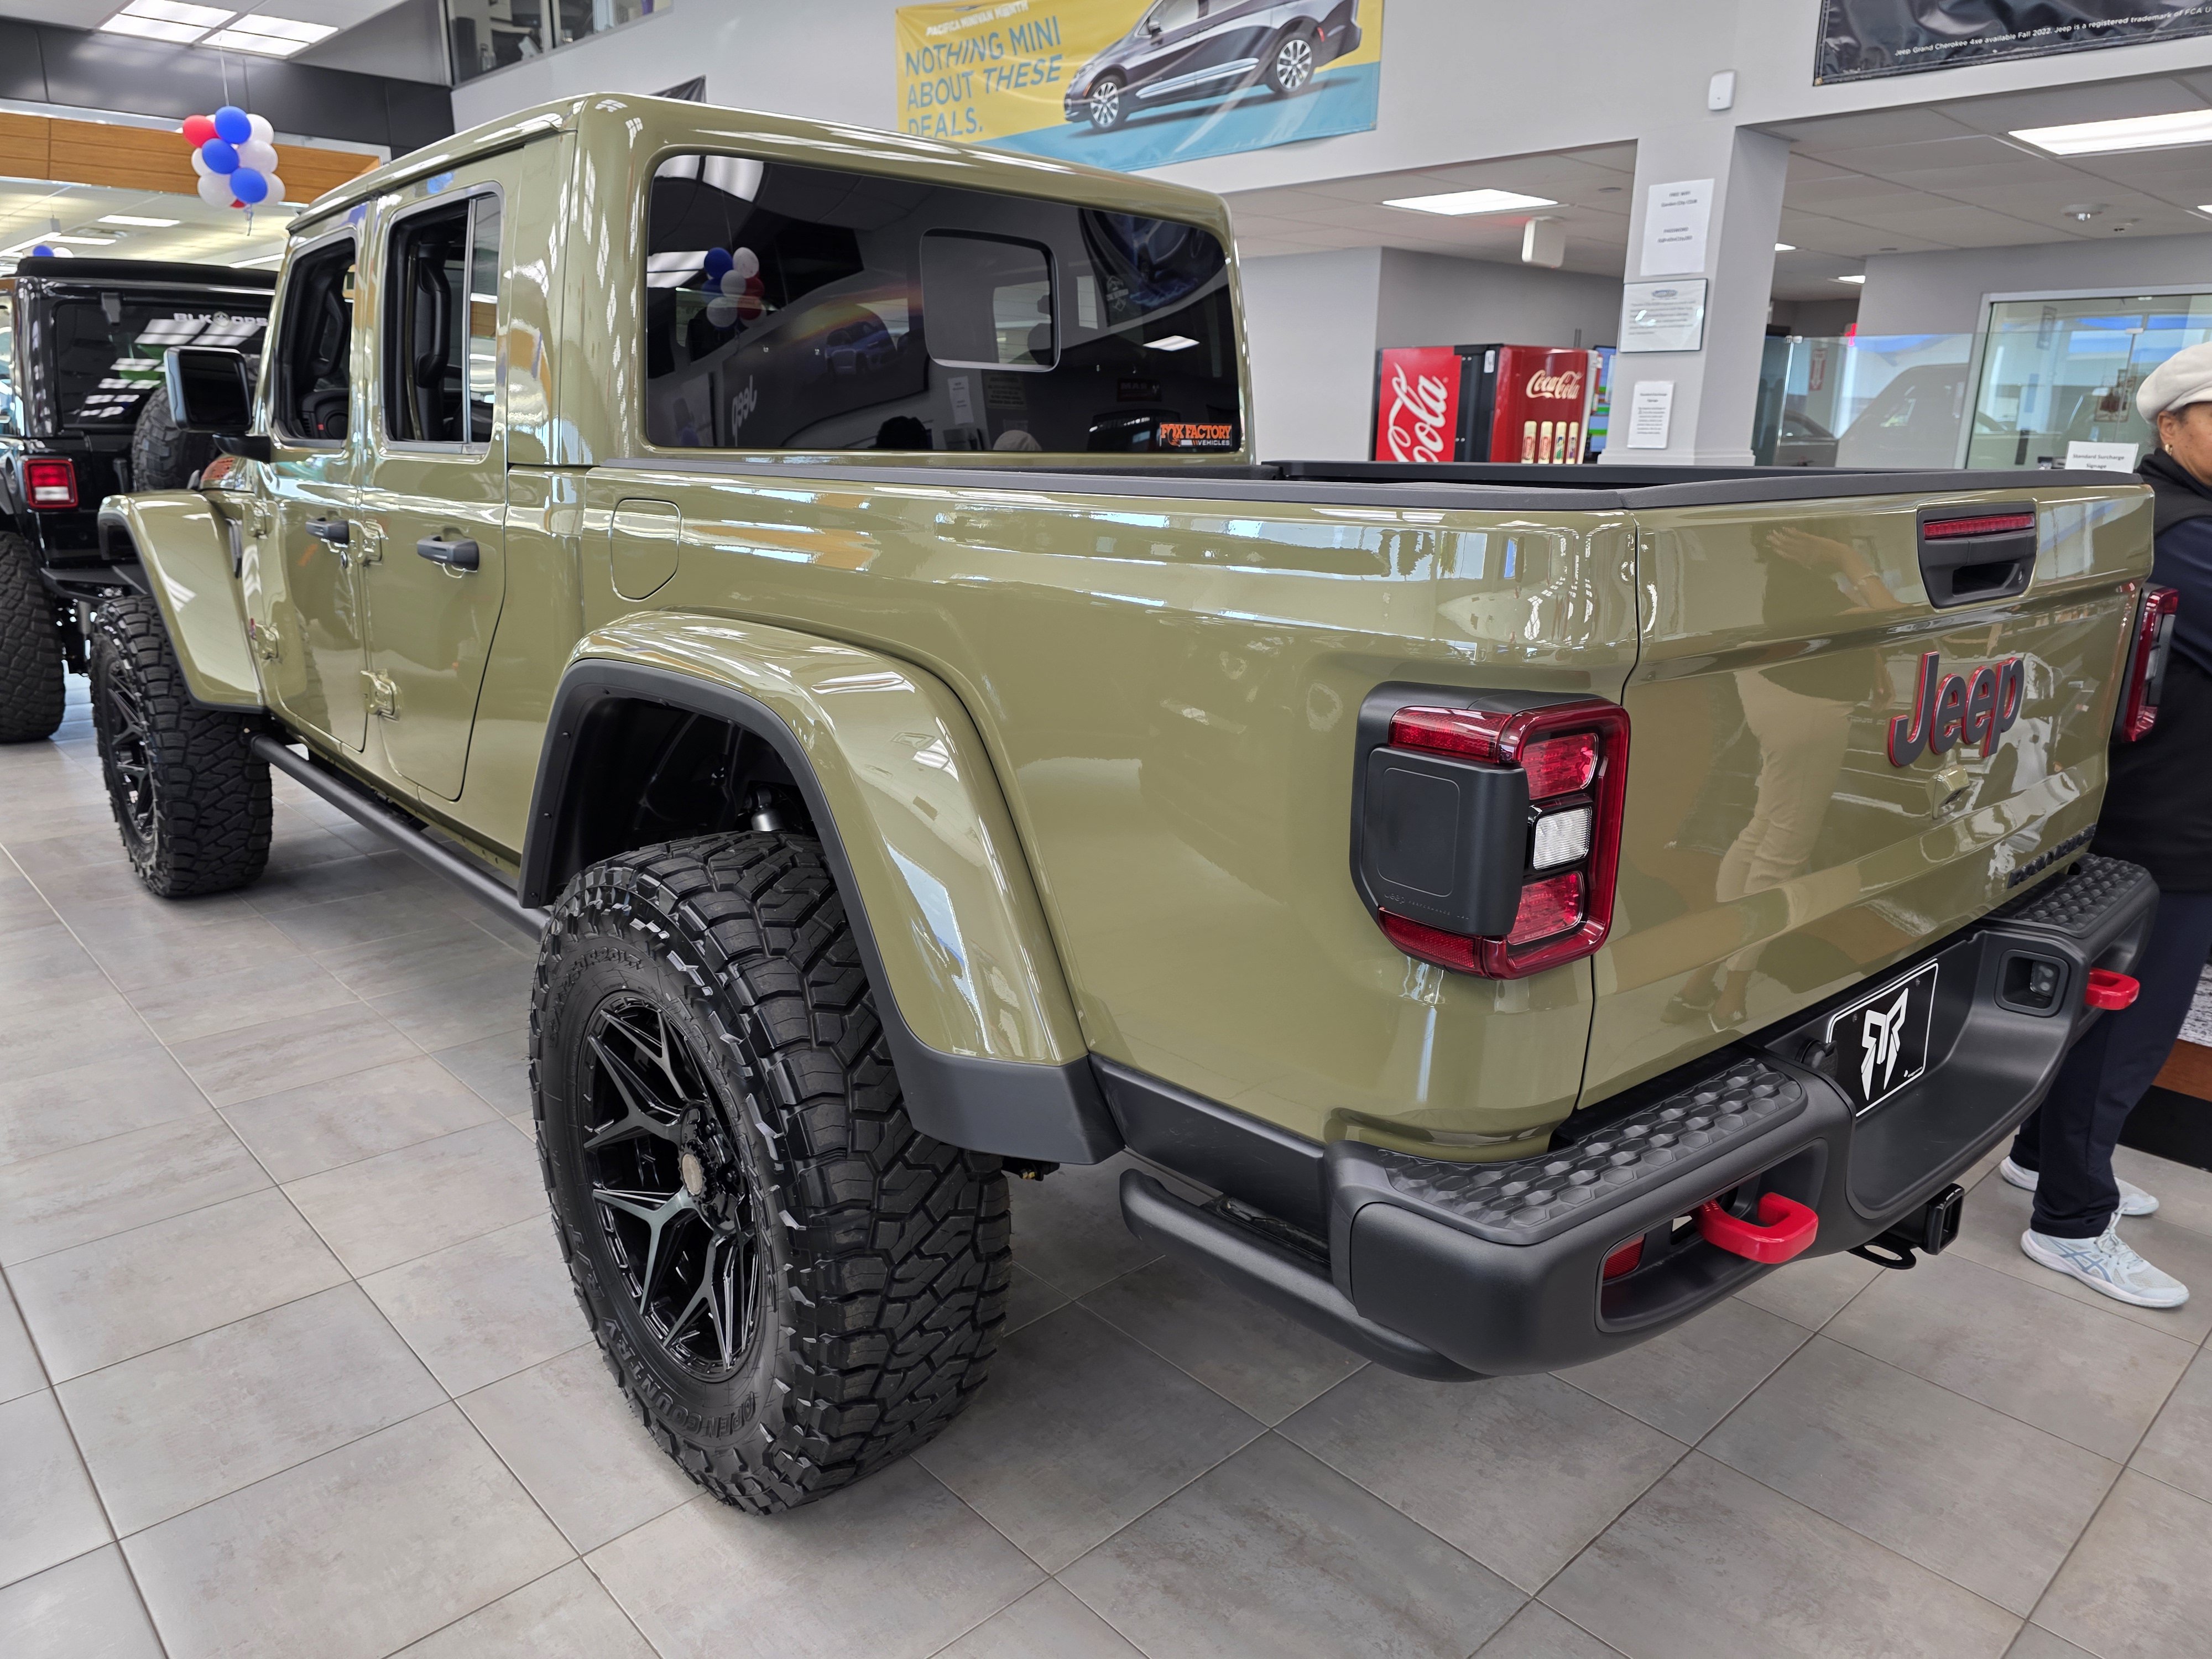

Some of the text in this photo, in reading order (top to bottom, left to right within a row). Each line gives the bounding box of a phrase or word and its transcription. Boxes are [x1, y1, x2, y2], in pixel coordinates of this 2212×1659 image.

[905, 15, 1062, 77] NOTHING MINI
[926, 19, 961, 36] PACIFICA
[960, 9, 994, 28] MINIVAN
[1895, 47, 1911, 56] Jeep
[1913, 44, 1934, 54] Grand
[1935, 39, 1968, 50] Cherokee
[1984, 33, 2016, 44] available
[2018, 30, 2031, 39] Fall
[2088, 17, 2129, 29] registered
[2130, 12, 2172, 24] trademark
[2174, 9, 2183, 18] of
[2184, 7, 2202, 15] FCA
[907, 54, 1063, 111] ABOUT THESE
[908, 107, 984, 138] DEALS.
[174, 312, 269, 327] BLK OPS
[1161, 424, 1185, 445] FOX
[1185, 425, 1232, 439] FACTORY
[1887, 651, 2025, 767] Jeep
[602, 1317, 703, 1435] COUNTRY
[706, 1391, 757, 1438] OPEN
